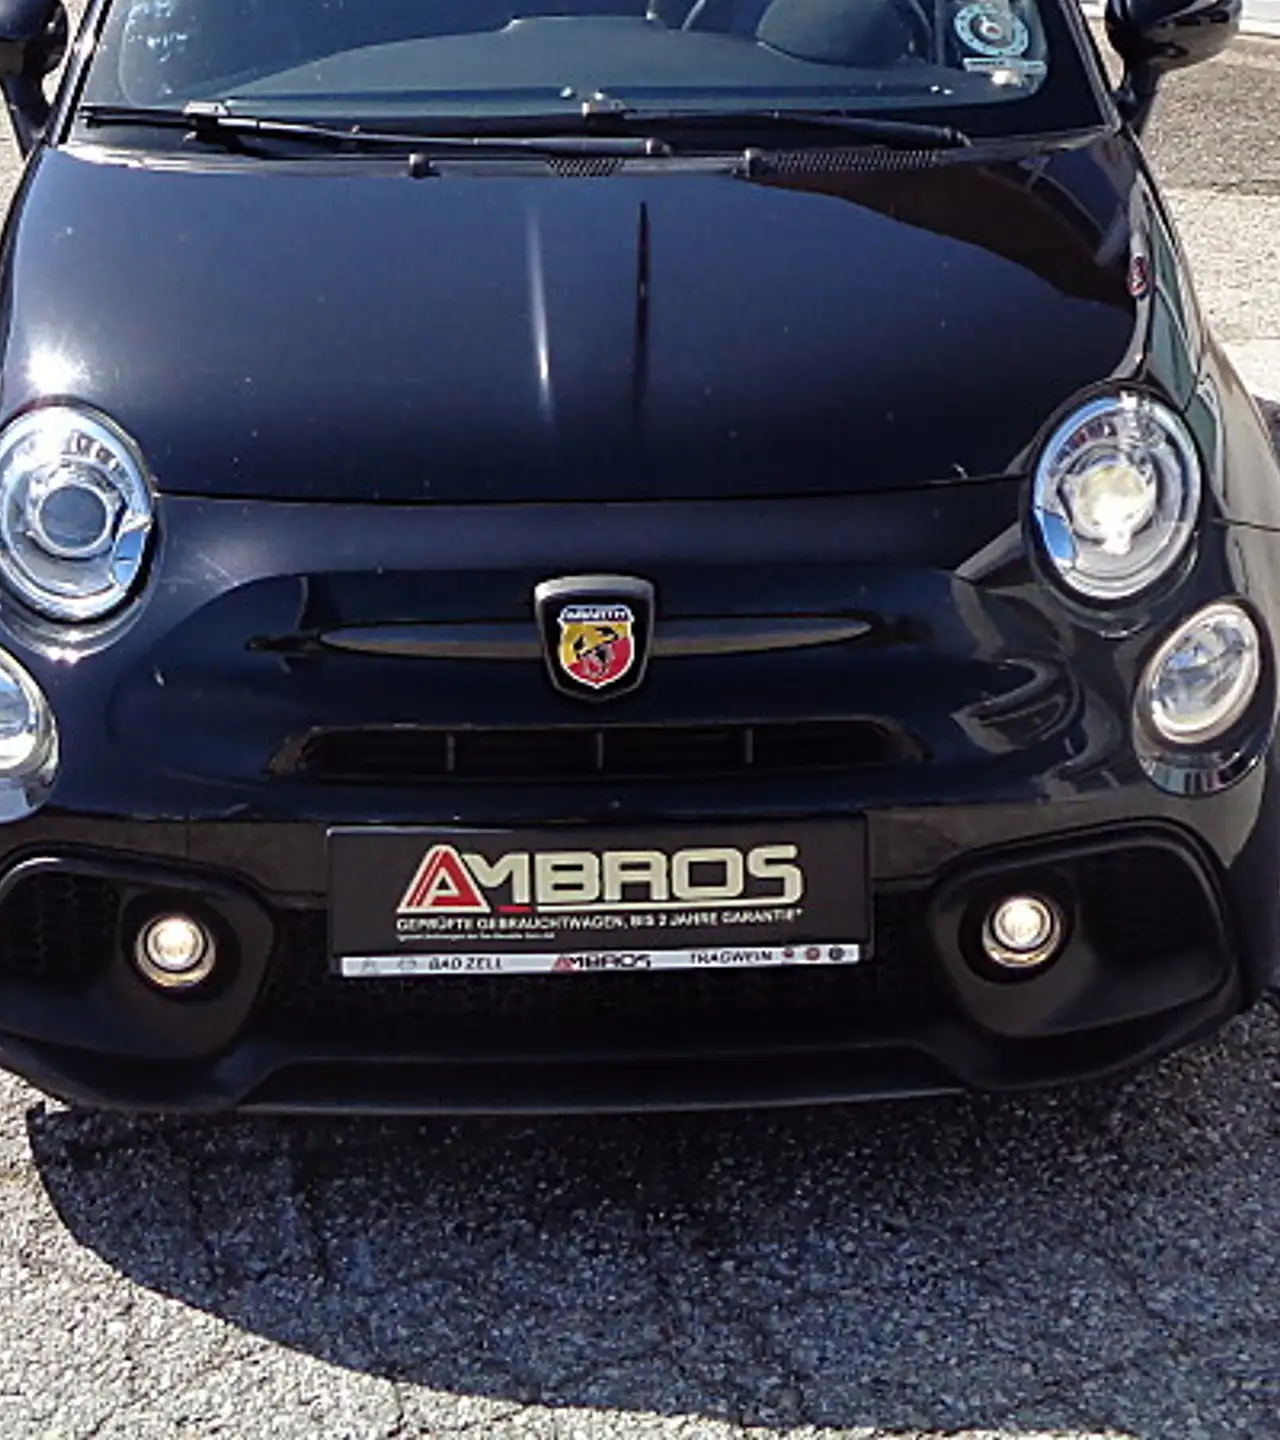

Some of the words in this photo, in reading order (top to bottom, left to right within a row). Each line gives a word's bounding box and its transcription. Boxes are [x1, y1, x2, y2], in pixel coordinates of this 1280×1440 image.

[396, 844, 804, 913] AMBROS
[396, 917, 474, 932] GEPRÜFTE
[670, 912, 718, 927] JAHRE
[465, 957, 502, 970] ZELL
[552, 954, 652, 972] AMBROS
